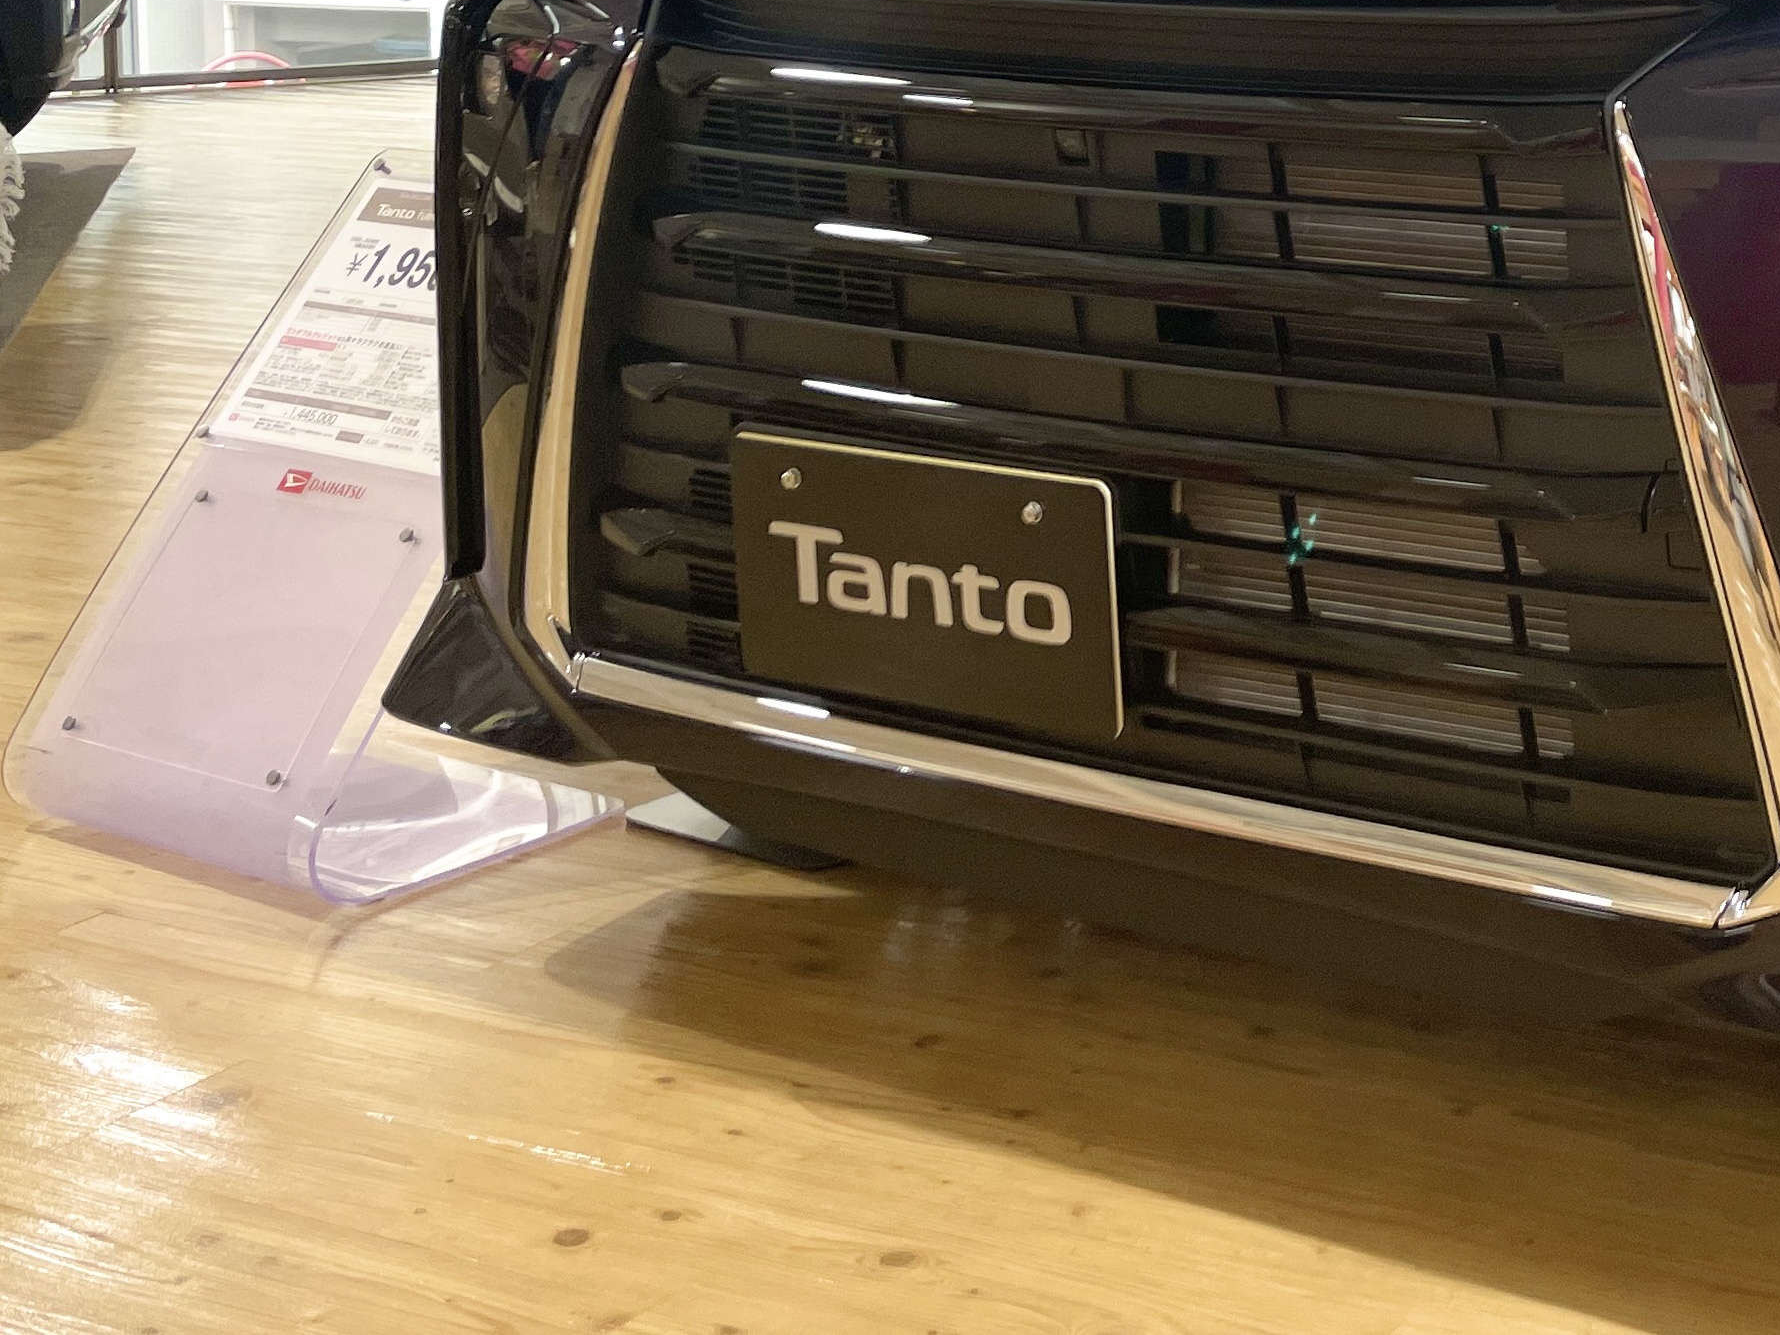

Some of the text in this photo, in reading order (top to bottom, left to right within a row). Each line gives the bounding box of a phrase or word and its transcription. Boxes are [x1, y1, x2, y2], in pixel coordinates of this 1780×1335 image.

[377, 203, 416, 219] Tanto
[309, 478, 368, 500] DAIHATSU
[768, 520, 1073, 646] Tanto
